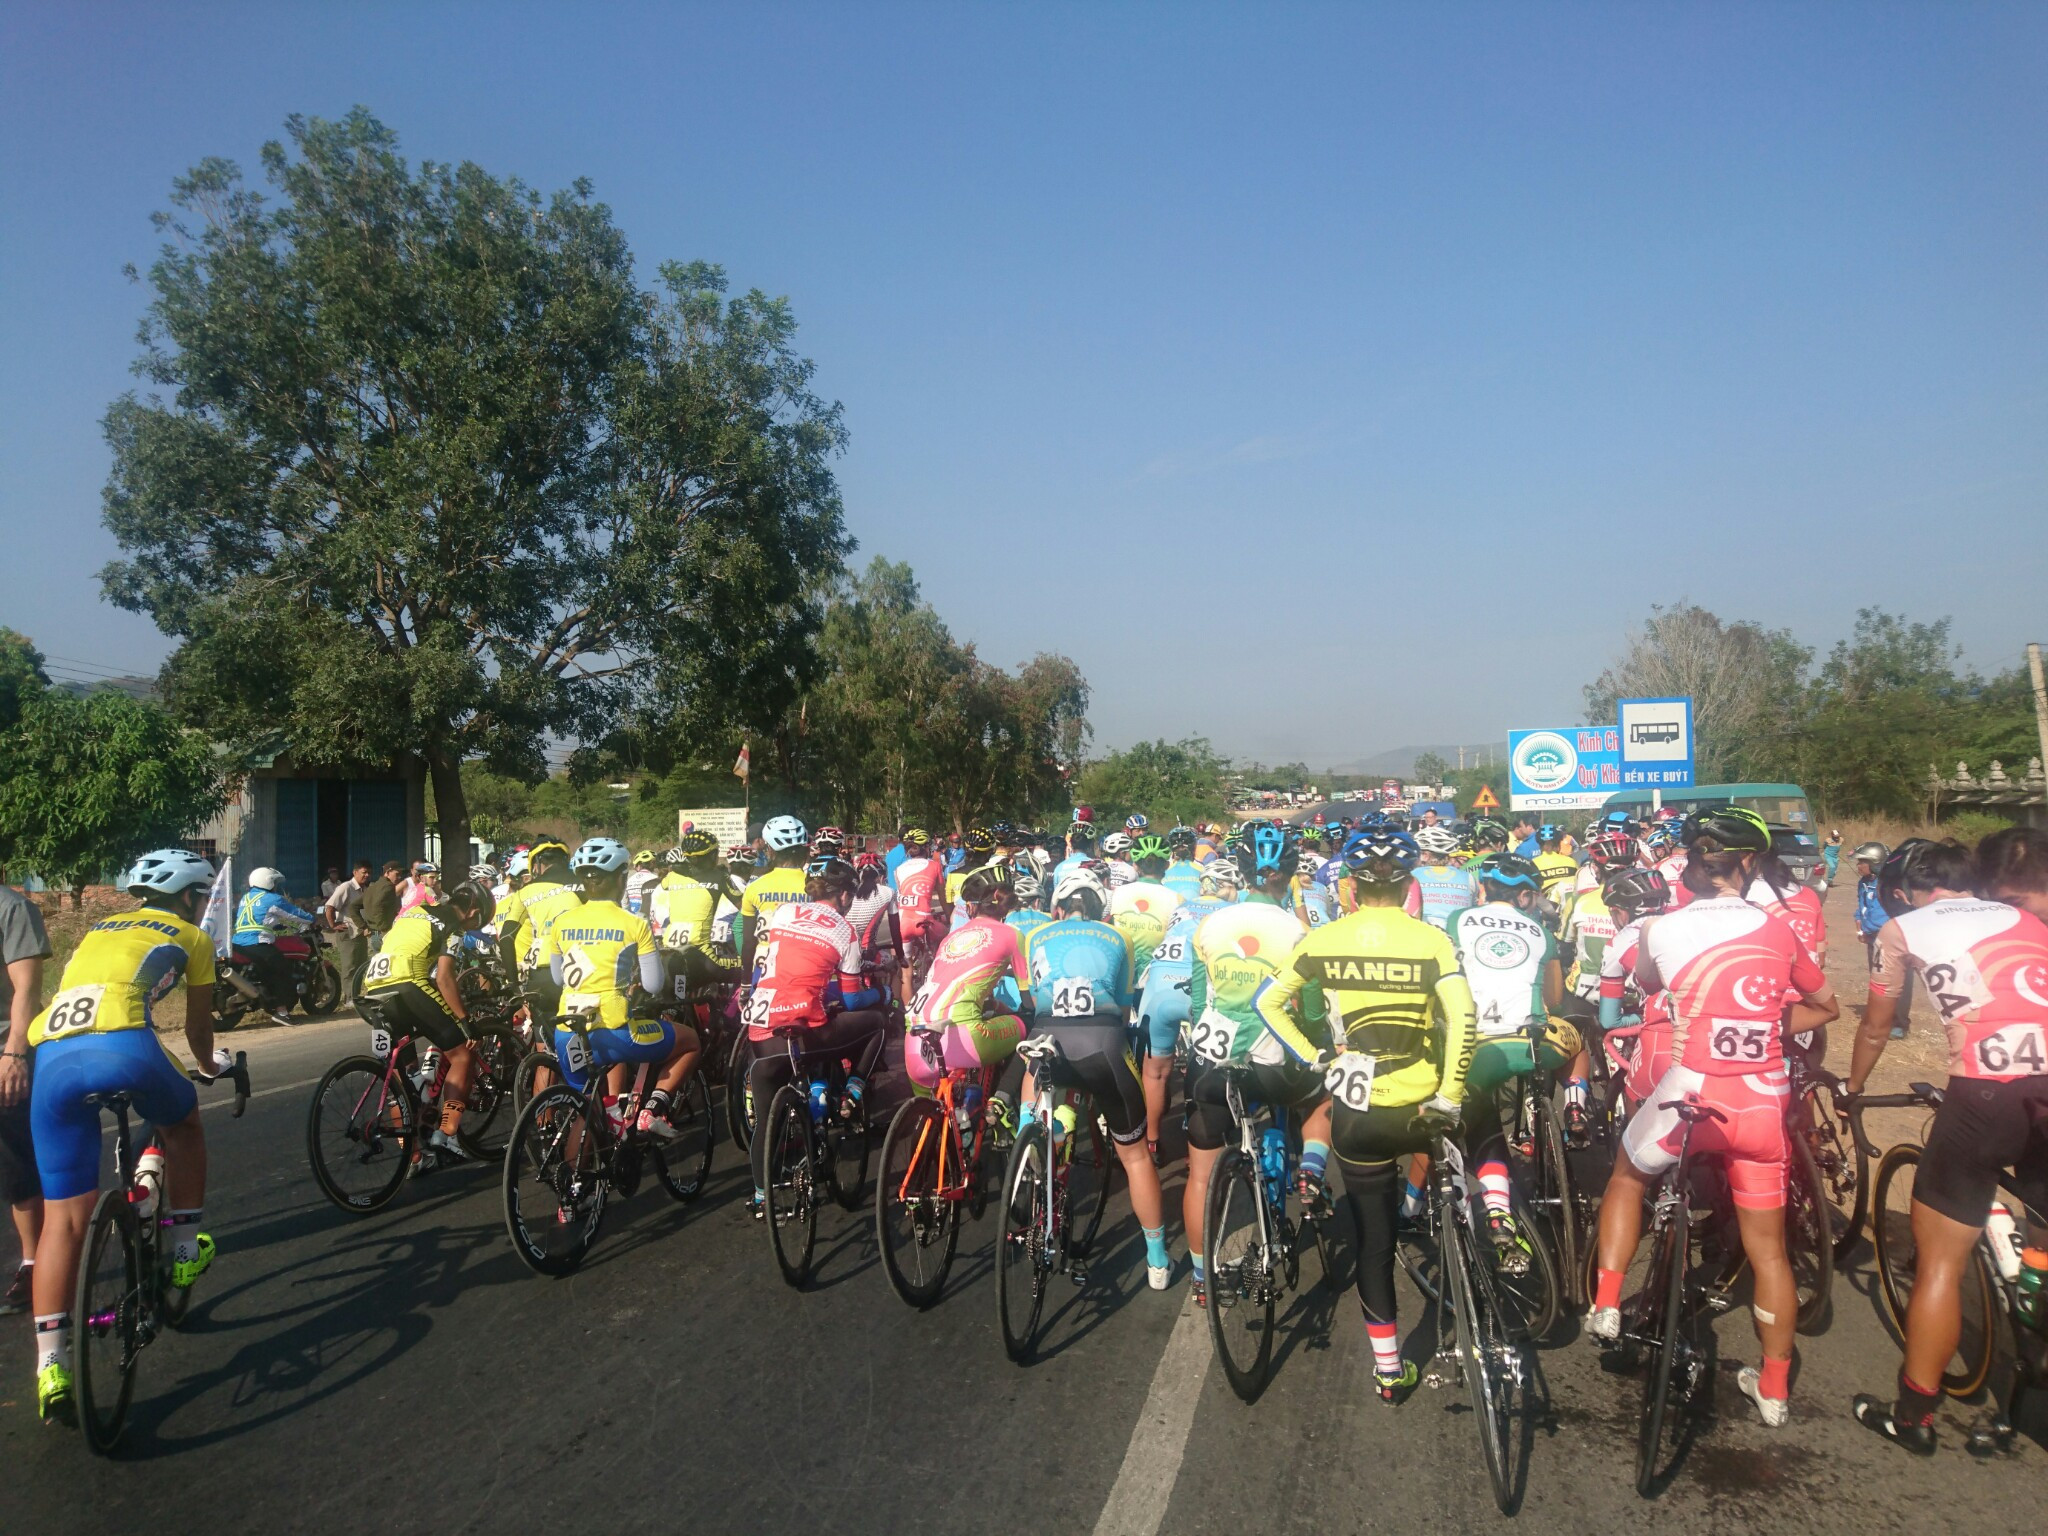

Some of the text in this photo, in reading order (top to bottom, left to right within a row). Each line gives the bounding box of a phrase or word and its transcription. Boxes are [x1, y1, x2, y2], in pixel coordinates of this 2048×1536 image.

[1578, 731, 1602, 752] Kính
[1578, 764, 1598, 788] Quý
[1625, 768, 1688, 783] BẾN XE BUÝT
[90, 920, 180, 937] HAILAND
[561, 929, 624, 942] THAILAND
[1463, 916, 1541, 937] AGPPS
[669, 930, 690, 946] 46
[1033, 929, 1120, 948] KAZAKHSTAN
[1154, 943, 1182, 960] 36
[367, 958, 390, 980] 49
[562, 953, 583, 989] 70
[1323, 961, 1422, 983] HANOI
[676, 980, 685, 993] 46
[1926, 963, 1972, 1019] 64
[743, 997, 769, 1025] 82
[1053, 986, 1092, 1014] 45
[48, 996, 96, 1033] 68
[375, 1034, 388, 1052] 49
[1193, 1022, 1230, 1060] 23
[1714, 1026, 1767, 1058] 65
[1979, 1032, 2045, 1072] 64
[570, 1042, 584, 1064] 70
[922, 1041, 934, 1065] 90
[1330, 1067, 1369, 1106] 26
